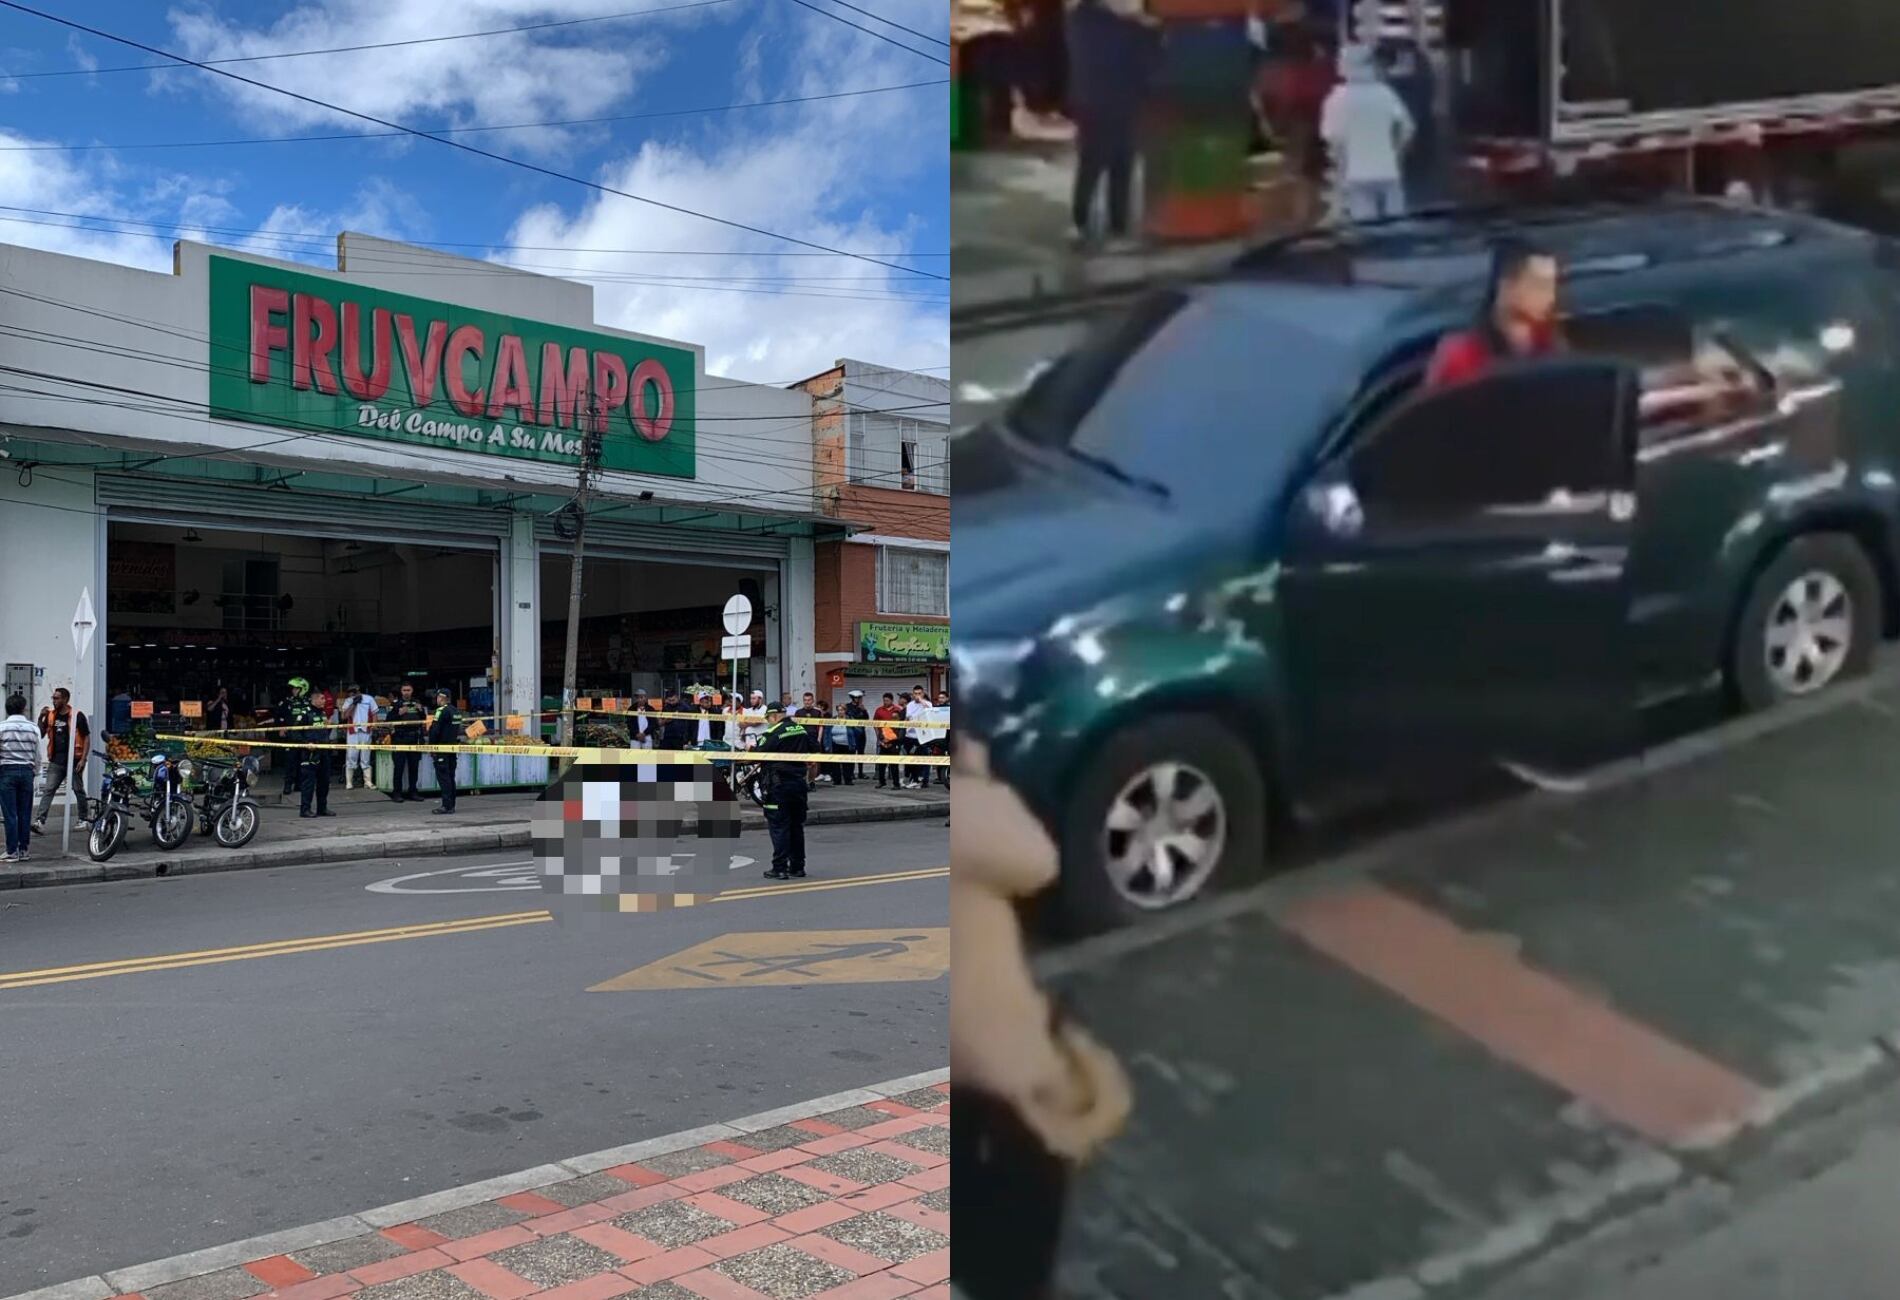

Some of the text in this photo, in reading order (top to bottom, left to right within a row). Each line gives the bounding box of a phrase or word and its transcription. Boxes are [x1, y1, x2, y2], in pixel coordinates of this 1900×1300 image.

[249, 284, 675, 442] FRUVCAMPO
[358, 404, 583, 456] Del Campo A Su Mes
